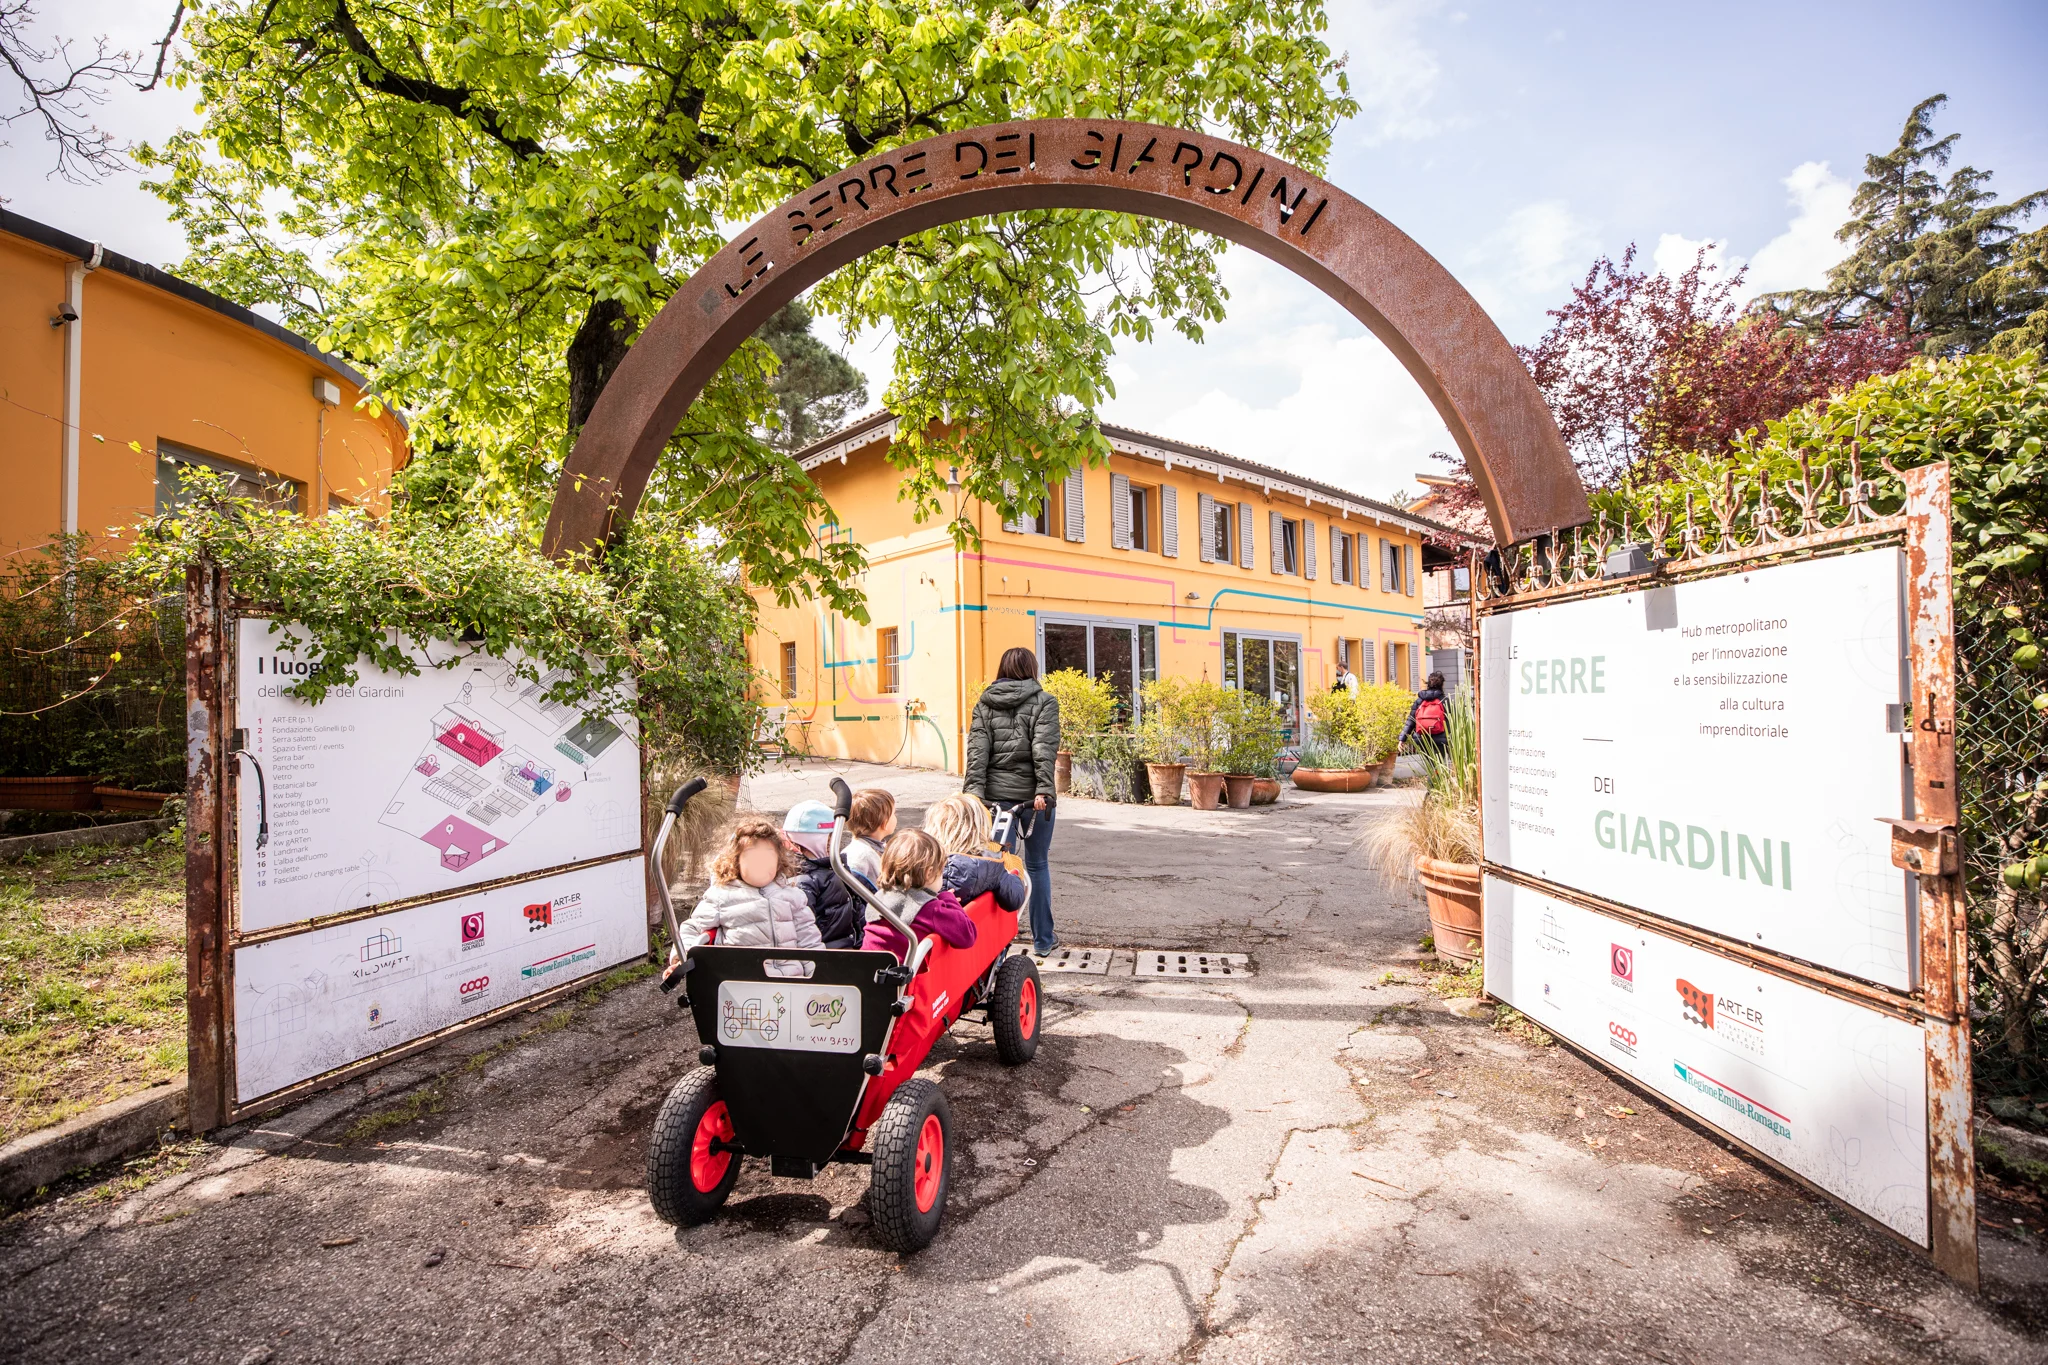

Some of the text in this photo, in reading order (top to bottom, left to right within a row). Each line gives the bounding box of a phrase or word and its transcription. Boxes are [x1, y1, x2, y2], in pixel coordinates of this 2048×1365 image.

[725, 131, 1328, 298] LE SERRE DEI GIARDINI
[1681, 618, 1788, 638] Hub metropolitano
[1508, 645, 1518, 660] LE
[1692, 644, 1788, 664] per l'innovazione
[258, 656, 334, 679] I luog
[1520, 655, 1605, 695] SERRE
[1673, 671, 1788, 686] e la sensibilizzazione
[336, 685, 355, 697] dei
[358, 685, 404, 697] Giardini
[1719, 697, 1784, 711] alla cultura
[314, 725, 339, 733] Golinelli
[1699, 722, 1789, 738] imprenditoriale
[273, 782, 305, 790] Botanical
[1594, 775, 1615, 795] DEI
[273, 800, 305, 809] Kworking
[273, 810, 299, 818] Gabbia
[312, 807, 330, 815] leone
[285, 837, 312, 847] gARTen
[1594, 809, 1792, 891] GIARDINI
[273, 846, 309, 857] Landmark
[273, 874, 308, 884] Fasciatoio
[314, 867, 343, 878] changing
[344, 864, 360, 873] table
[274, 866, 300, 875] Toilette
[553, 892, 581, 908] ART-ER
[460, 975, 489, 994] coop
[1717, 997, 1763, 1026] ART-ER
[1609, 1021, 1638, 1046] coop
